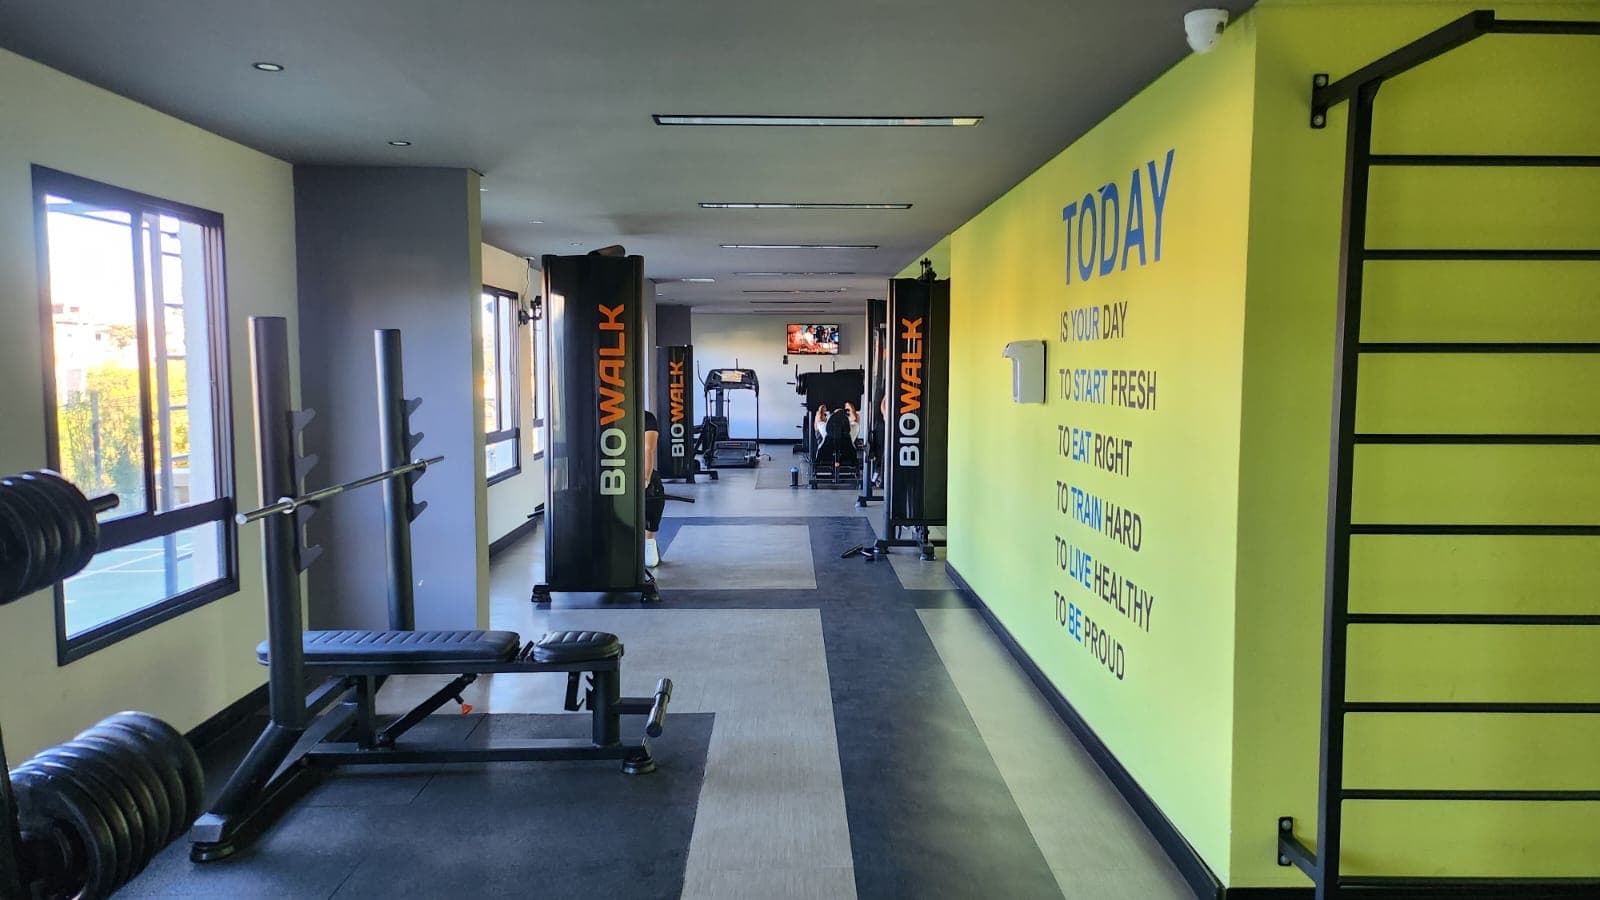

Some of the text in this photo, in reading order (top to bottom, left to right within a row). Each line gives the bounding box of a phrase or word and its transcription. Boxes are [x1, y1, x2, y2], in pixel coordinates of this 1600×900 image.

[1063, 149, 1175, 285] TODAY
[1060, 301, 1127, 342] IS YOUR DAY
[598, 303, 627, 496] BIOWALK
[669, 360, 685, 457] BIOWALK
[900, 317, 923, 467] BIOWALK
[1059, 369, 1156, 410] TO START FRESH
[1058, 425, 1132, 477] TO EAT RIGHT
[1057, 480, 1141, 552] TO TRAIN HARD
[1055, 536, 1153, 632] TO LIVE HEALTHY
[1054, 591, 1124, 680] TO BE PROUD
